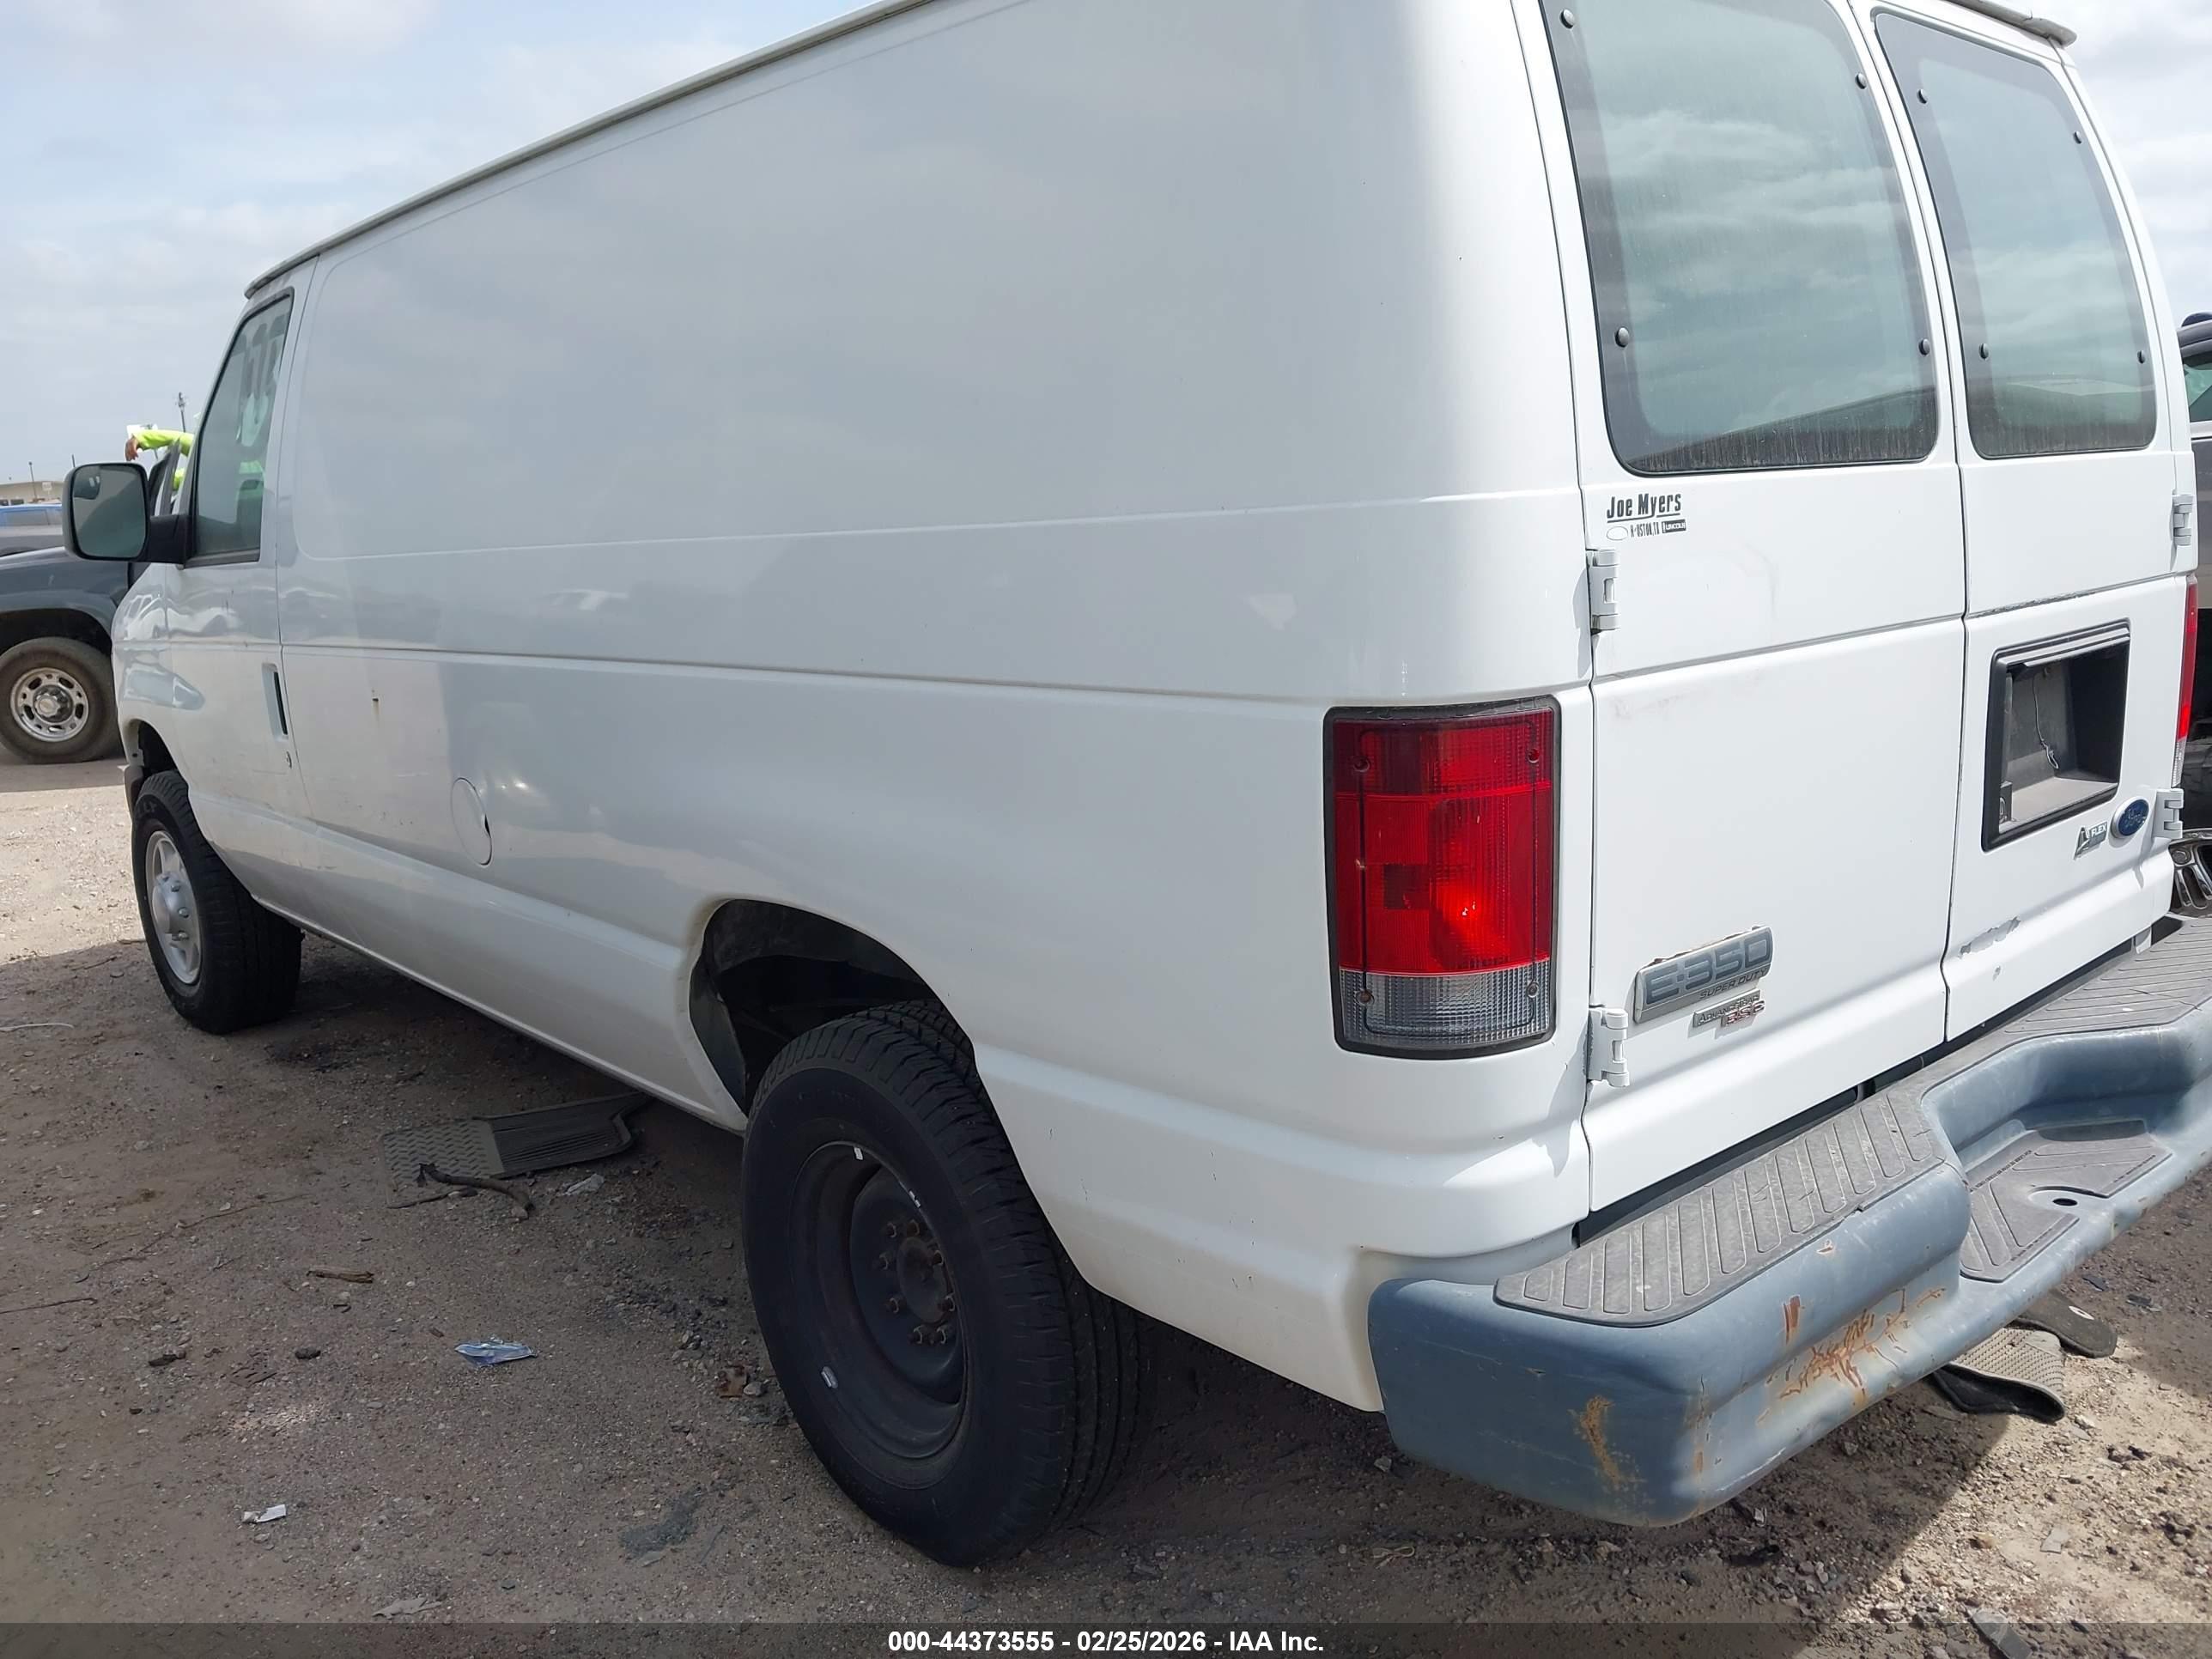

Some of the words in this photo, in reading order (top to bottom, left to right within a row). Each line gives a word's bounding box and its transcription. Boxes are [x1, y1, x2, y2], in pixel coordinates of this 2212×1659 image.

[1606, 496, 1632, 519] Joe
[1638, 493, 1681, 517] Myers
[2091, 823, 2107, 838] FLEX
[1645, 930, 1771, 1005] E-350
[1699, 980, 1736, 999] SUPER
[1738, 967, 1767, 985] DUTY
